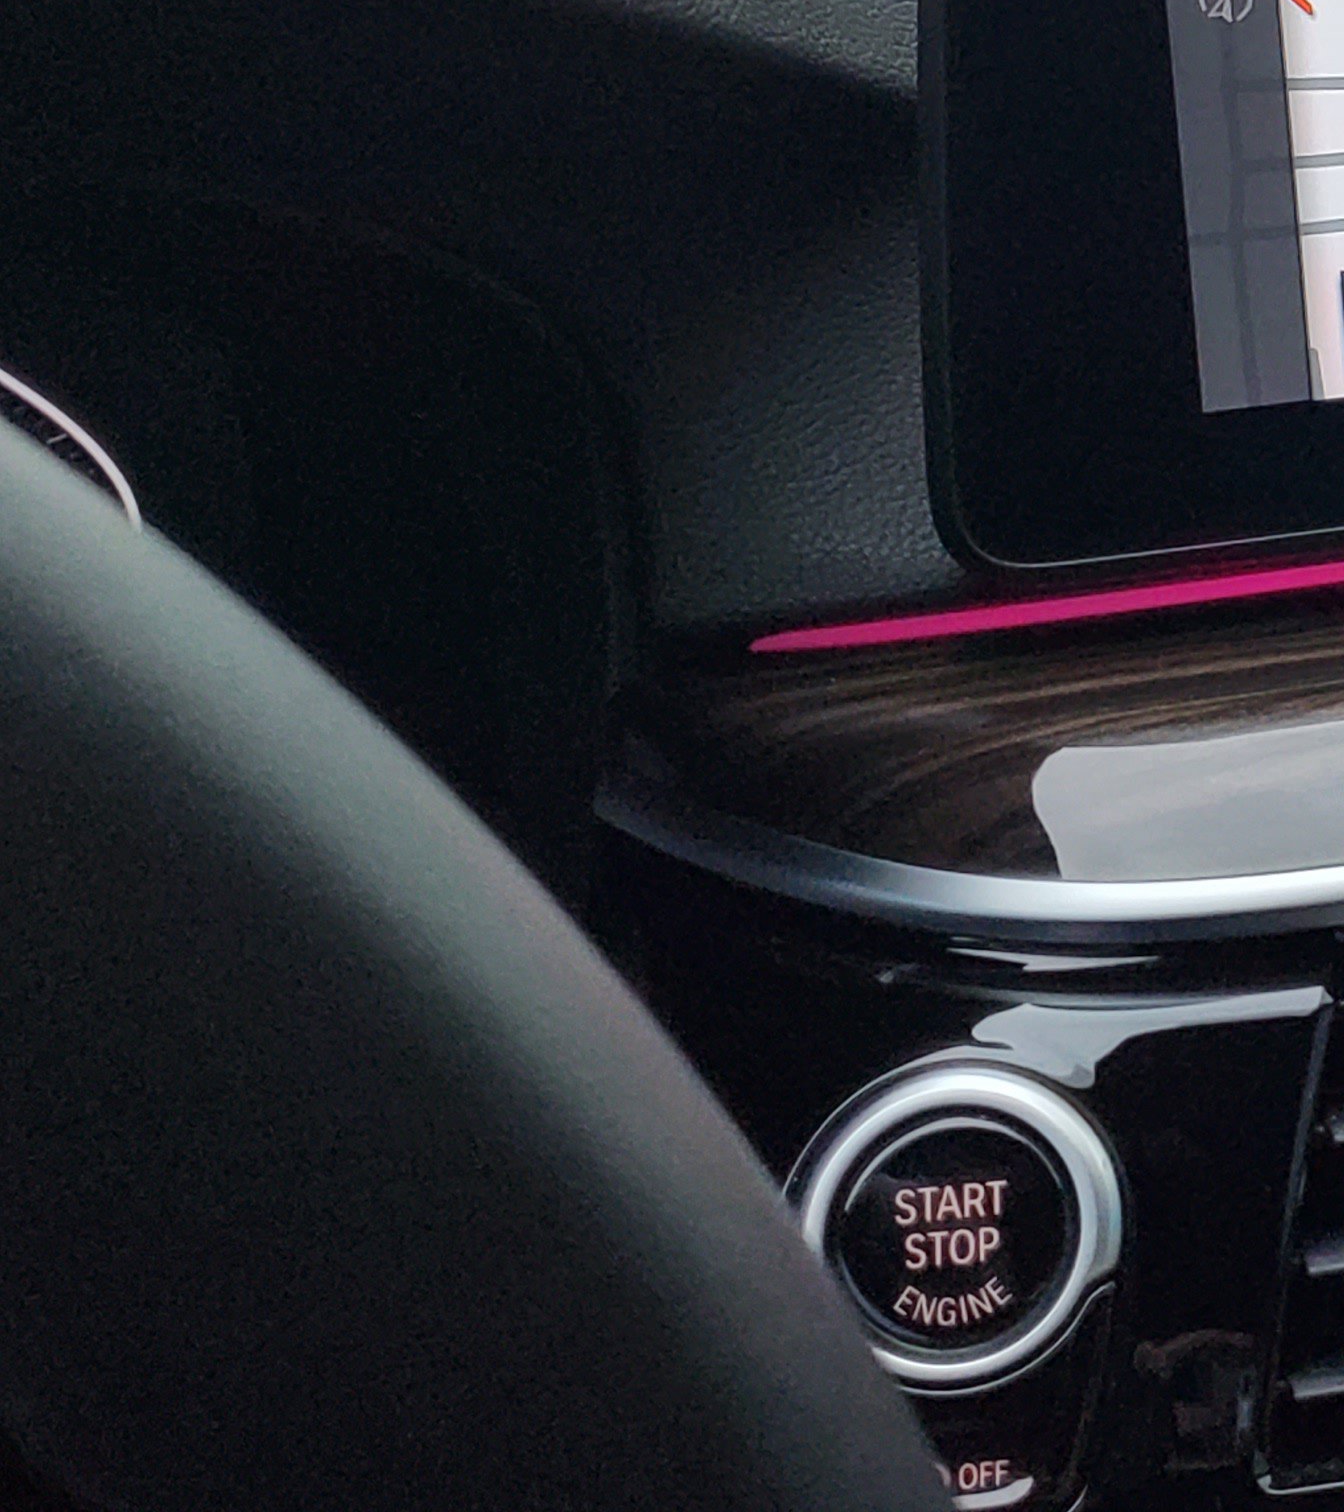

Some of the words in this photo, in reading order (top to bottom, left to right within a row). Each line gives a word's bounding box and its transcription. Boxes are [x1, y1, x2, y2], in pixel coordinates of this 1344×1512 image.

[894, 1179, 1008, 1226] START
[904, 1228, 999, 1271] STOP
[892, 1275, 1013, 1328] ENGINE
[958, 1459, 1011, 1489] OFF
